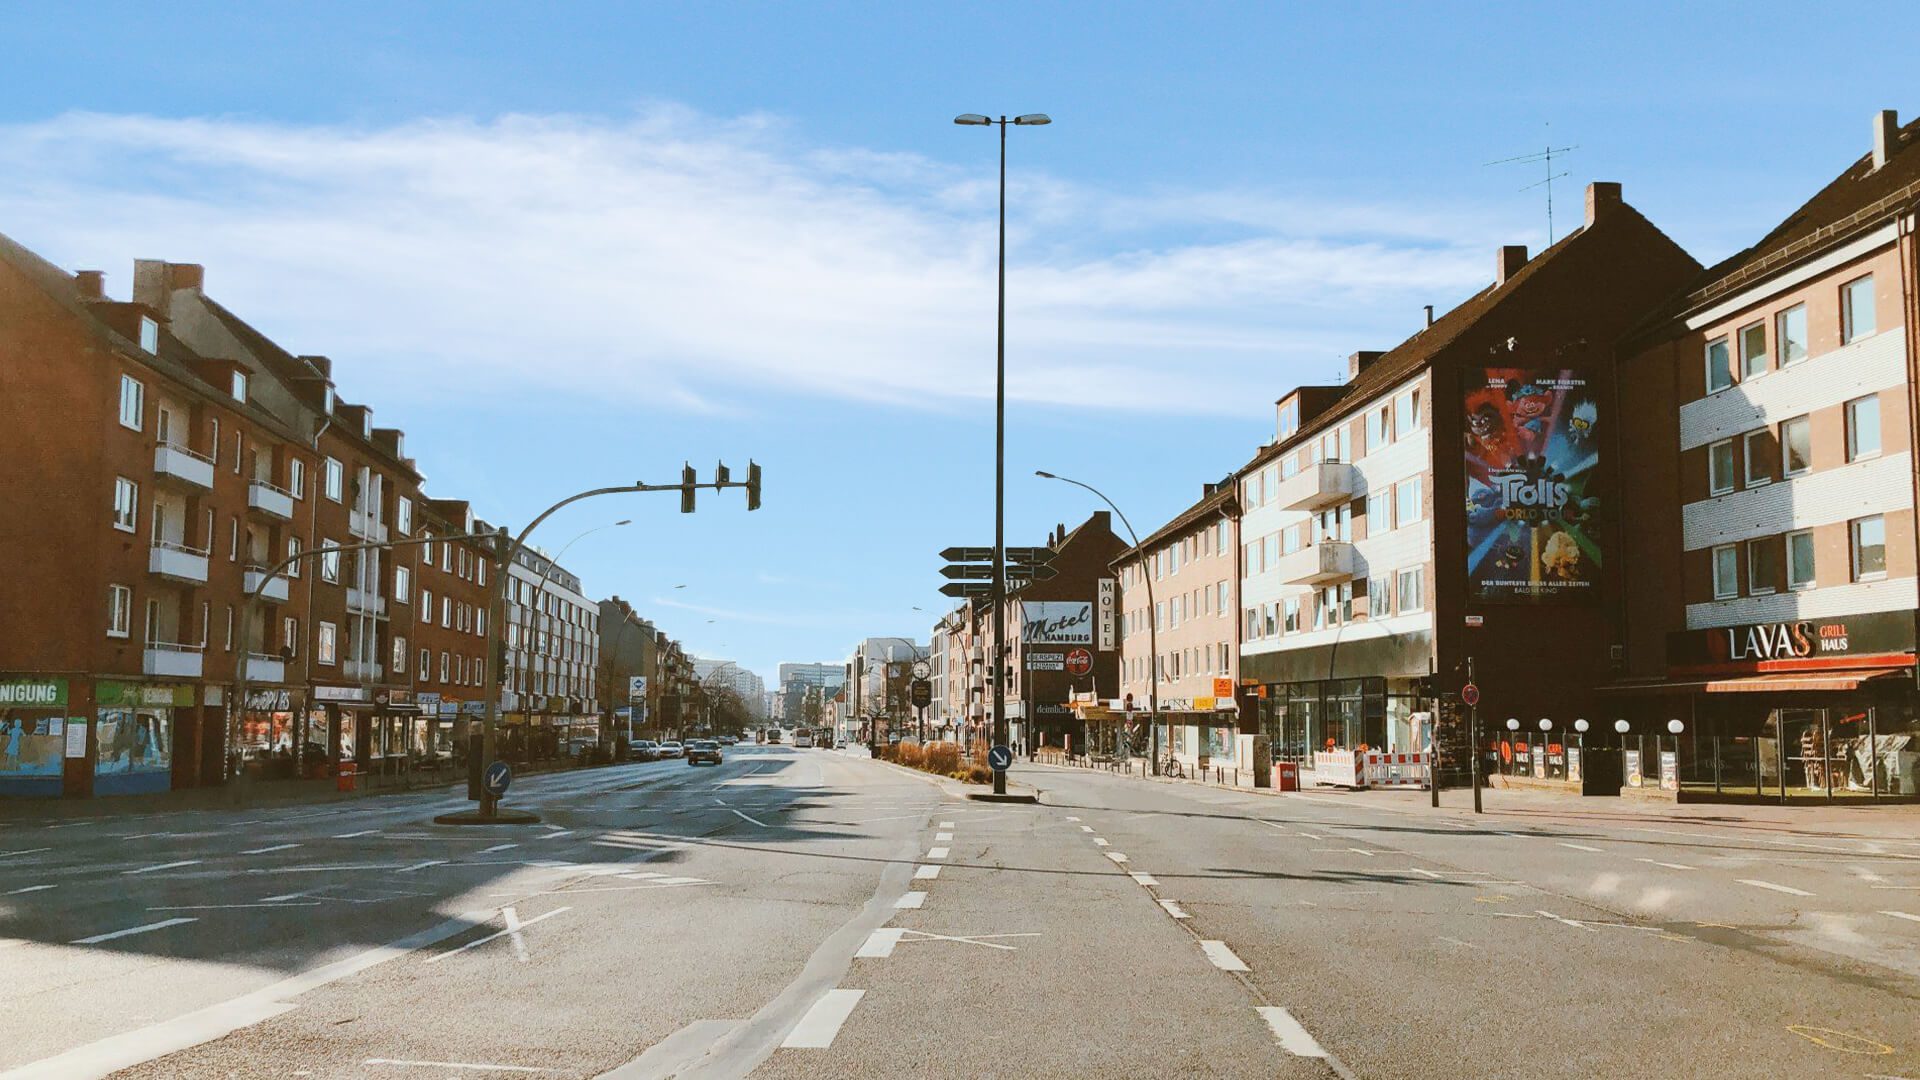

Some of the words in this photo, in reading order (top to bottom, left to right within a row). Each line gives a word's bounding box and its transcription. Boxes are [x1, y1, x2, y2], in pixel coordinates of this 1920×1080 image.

[1023, 605, 1090, 641] Motel
[1100, 583, 1113, 647] MOTEL
[1045, 634, 1090, 642] HAMBURG
[1820, 624, 1848, 638] GRILL
[1728, 622, 1812, 660] LAVAS
[1821, 637, 1848, 652] HAUS
[0, 684, 57, 702] NIGUNG
